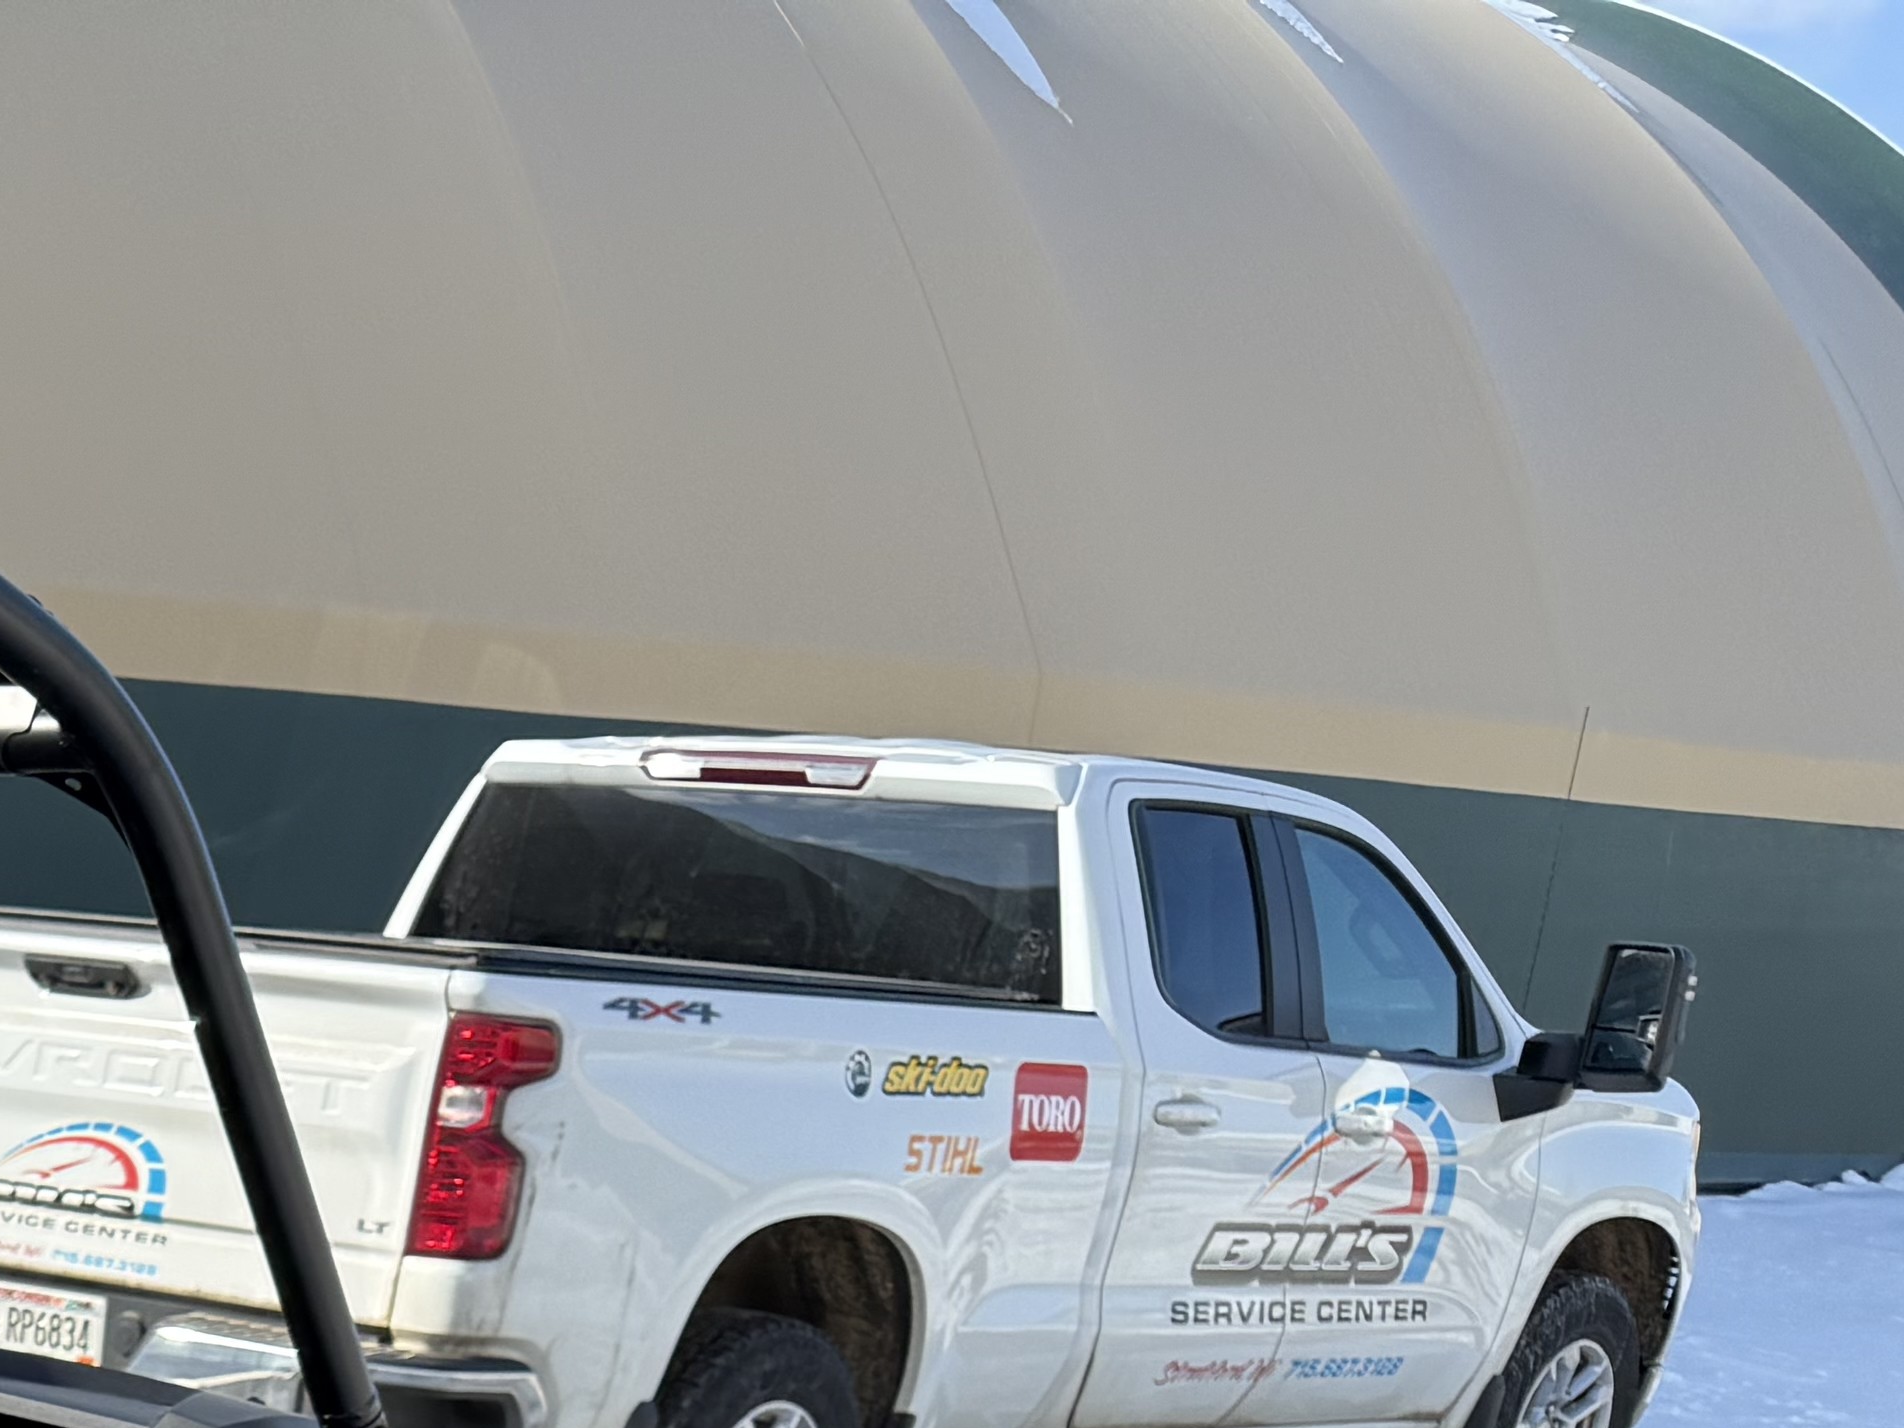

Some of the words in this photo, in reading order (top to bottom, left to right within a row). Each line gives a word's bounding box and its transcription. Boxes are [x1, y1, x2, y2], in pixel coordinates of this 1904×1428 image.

[882, 1056, 989, 1098] ski-doo
[1017, 1093, 1082, 1134] TORO
[904, 1134, 984, 1176] STIHL
[63, 1219, 170, 1247] CENTER
[357, 1219, 389, 1235] LT
[4, 1306, 92, 1352] RP6834
[1169, 1300, 1307, 1325] SERVICE
[1315, 1298, 1428, 1324] CENTER
